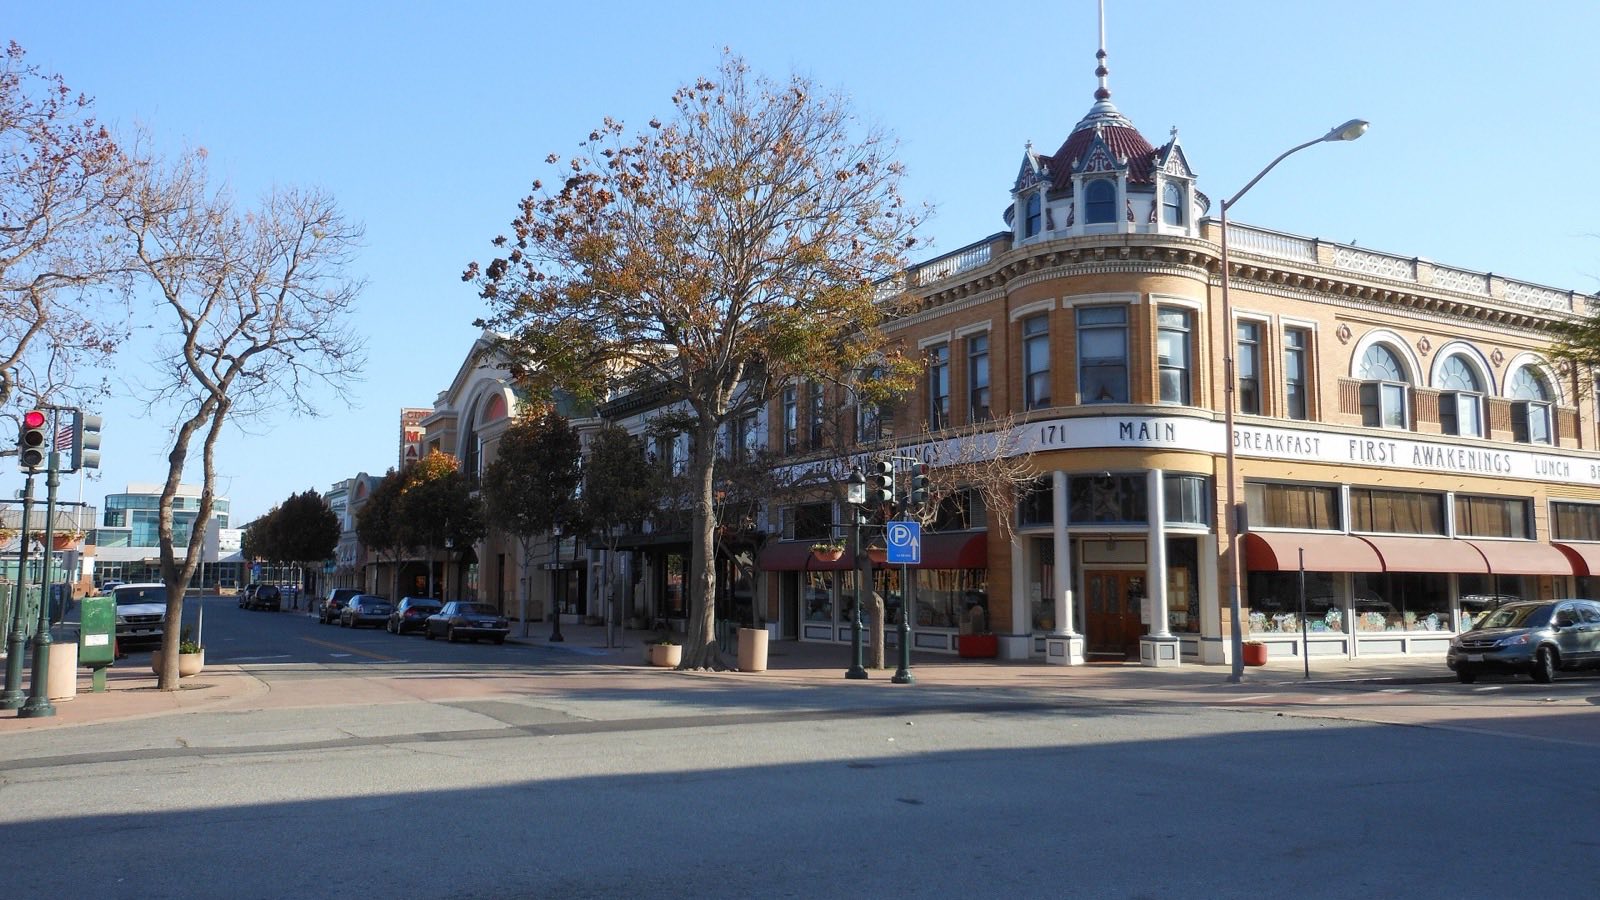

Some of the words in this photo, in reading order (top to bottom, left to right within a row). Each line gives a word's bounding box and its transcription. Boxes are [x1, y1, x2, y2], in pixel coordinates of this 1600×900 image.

[1040, 425, 1066, 444] 171
[1119, 421, 1176, 442] MAIN
[1234, 431, 1320, 454] BREAKFAST
[1349, 439, 1396, 463] FIRST
[1412, 445, 1511, 473] AWAKENINGS
[1534, 459, 1569, 477] LUNCH
[894, 527, 908, 543] P
